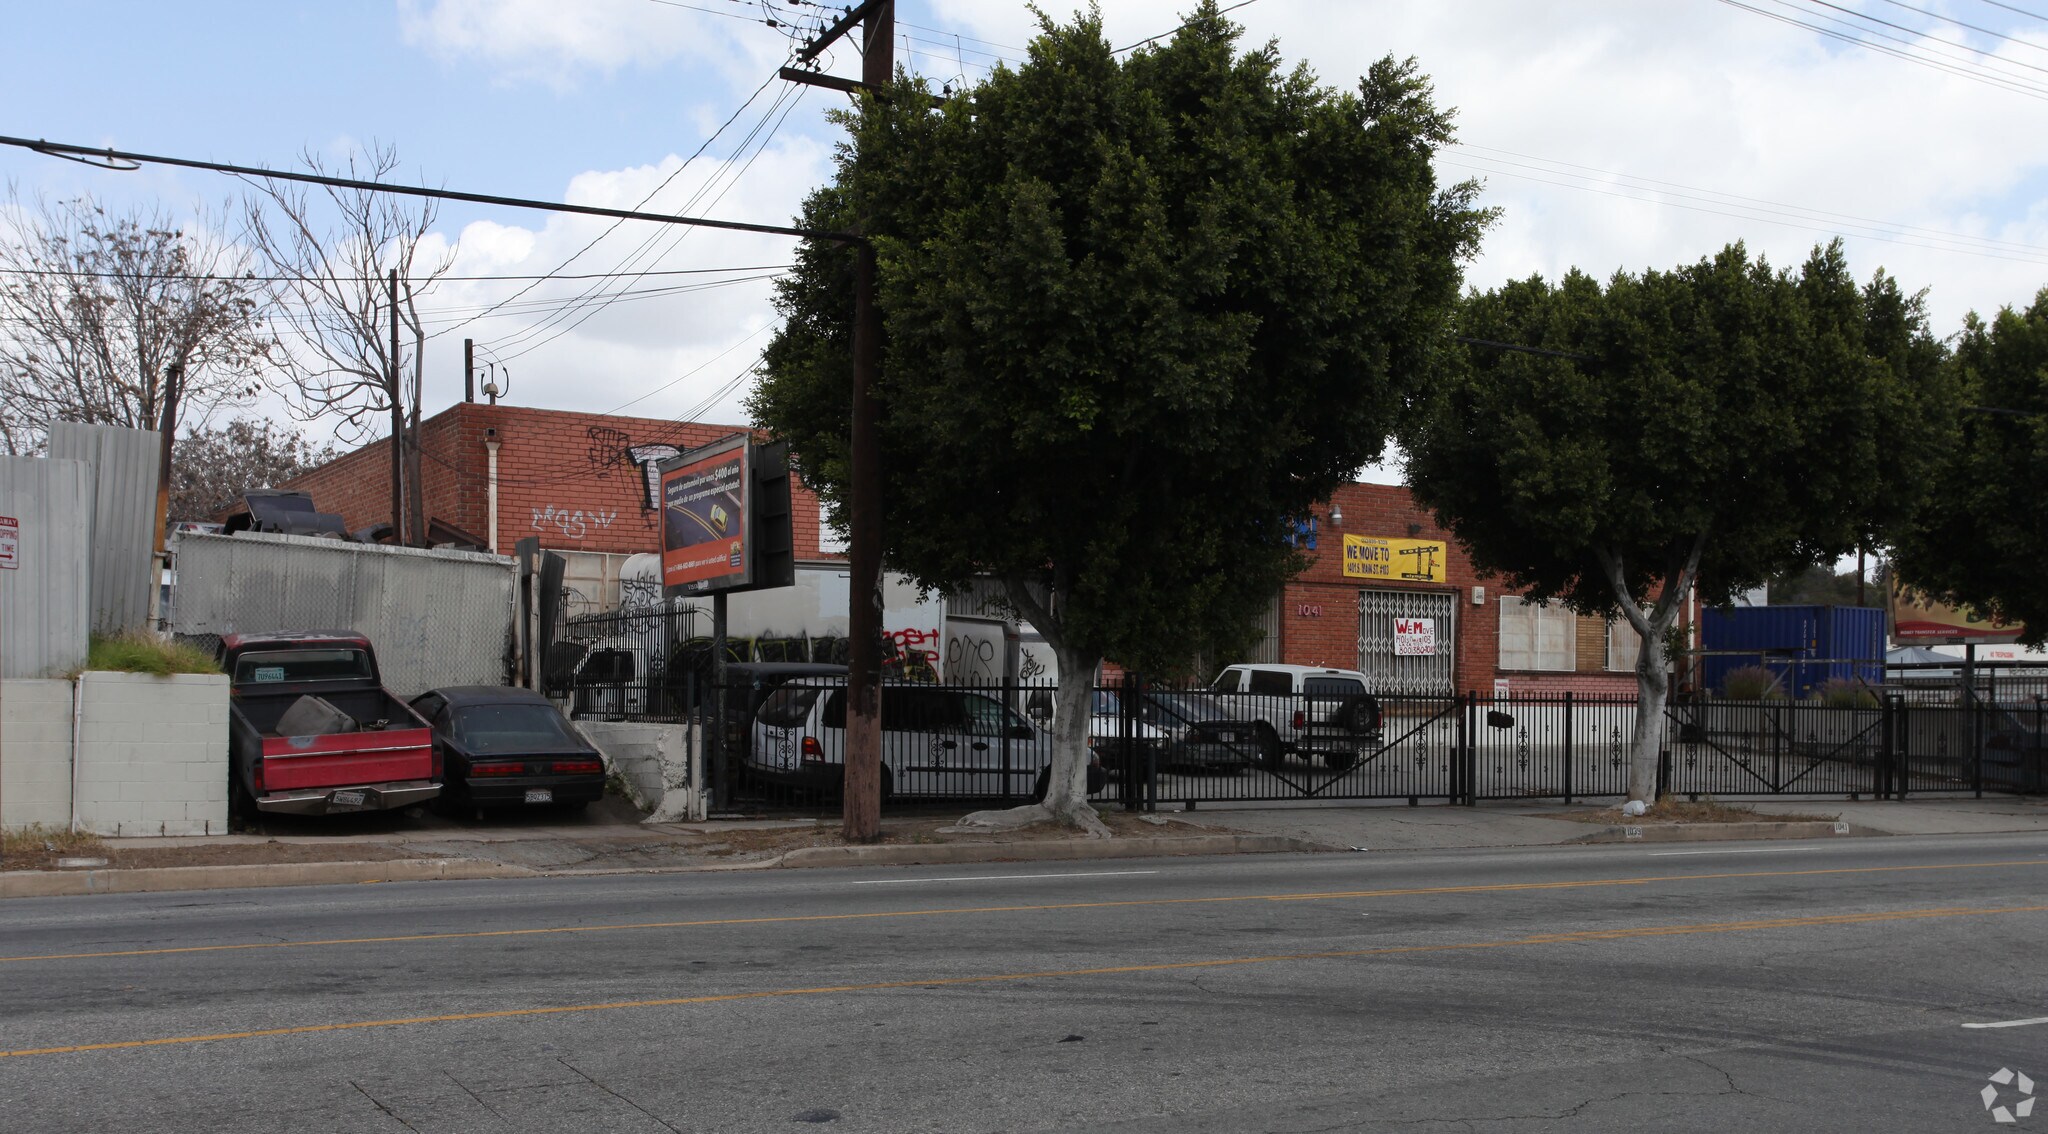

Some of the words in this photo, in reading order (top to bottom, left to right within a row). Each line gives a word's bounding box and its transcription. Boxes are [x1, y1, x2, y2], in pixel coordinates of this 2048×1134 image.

[714, 466, 727, 481] $400
[2, 543, 15, 553] TIME
[1346, 544, 1358, 559] WE
[1359, 545, 1378, 561] MOVE
[1380, 547, 1390, 562] TO
[1361, 564, 1372, 574] MAIN
[1298, 604, 1322, 617] 1041
[1395, 618, 1413, 635] WE
[1413, 621, 1434, 635] MOVE
